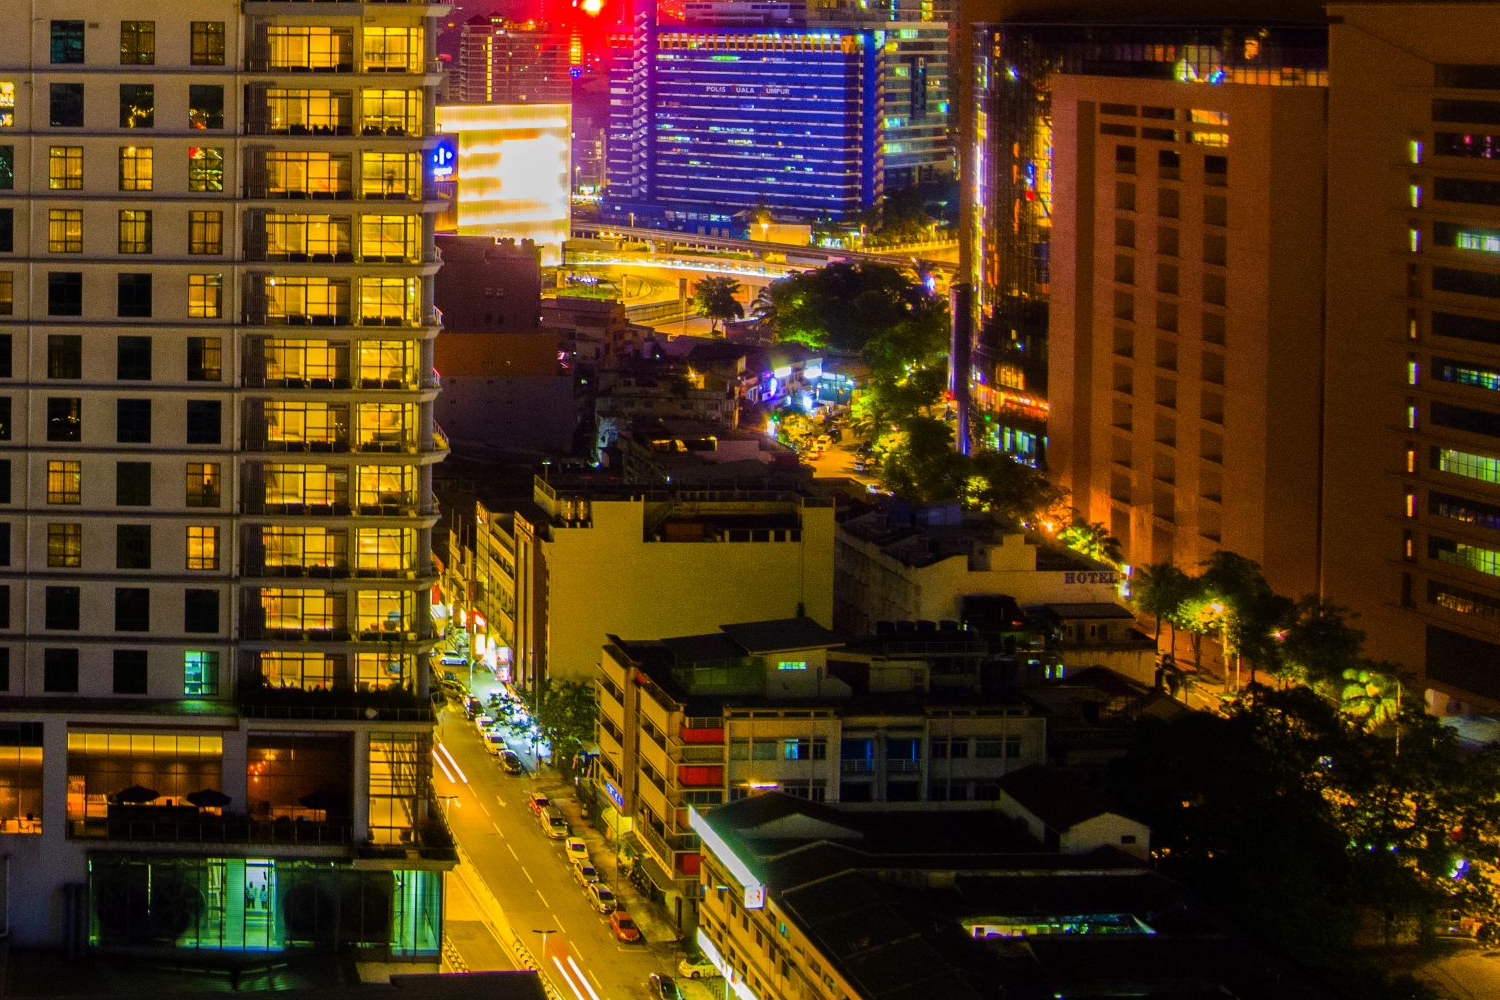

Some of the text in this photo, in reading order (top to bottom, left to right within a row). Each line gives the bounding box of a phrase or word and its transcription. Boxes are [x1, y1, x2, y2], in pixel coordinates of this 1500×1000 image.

[731, 86, 755, 94] UALA
[762, 87, 790, 95] UMPUR
[1065, 572, 1118, 584] HOTEL
